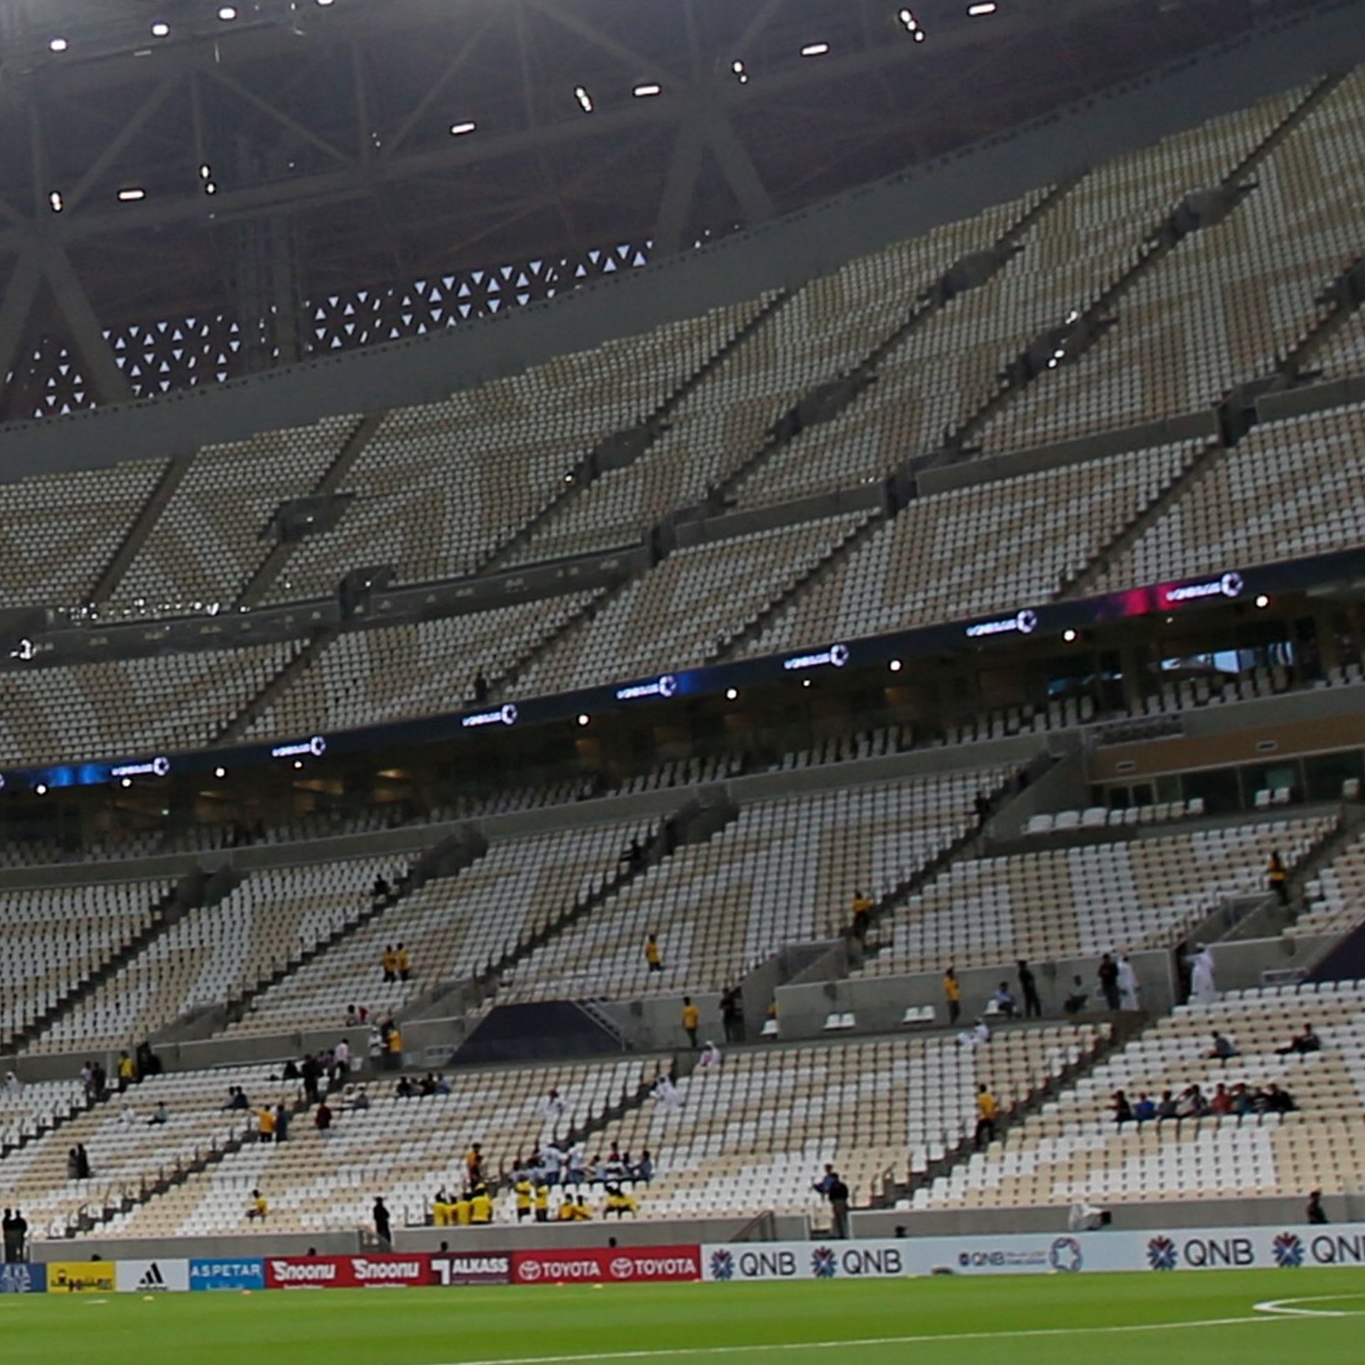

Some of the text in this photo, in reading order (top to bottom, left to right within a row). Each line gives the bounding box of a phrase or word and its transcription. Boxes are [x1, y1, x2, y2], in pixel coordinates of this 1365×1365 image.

[1184, 1238, 1254, 1267] QNB
[1311, 1235, 1365, 1263] QN
[191, 1264, 261, 1277] ASPETAR
[272, 1261, 336, 1281] Snoonu
[352, 1259, 420, 1279] Snoonu
[453, 1258, 509, 1273] ALKASS
[542, 1261, 601, 1277] TOYOTA
[634, 1258, 697, 1275] TOYOTA
[740, 1251, 796, 1277] QNB
[842, 1249, 902, 1274] QNB
